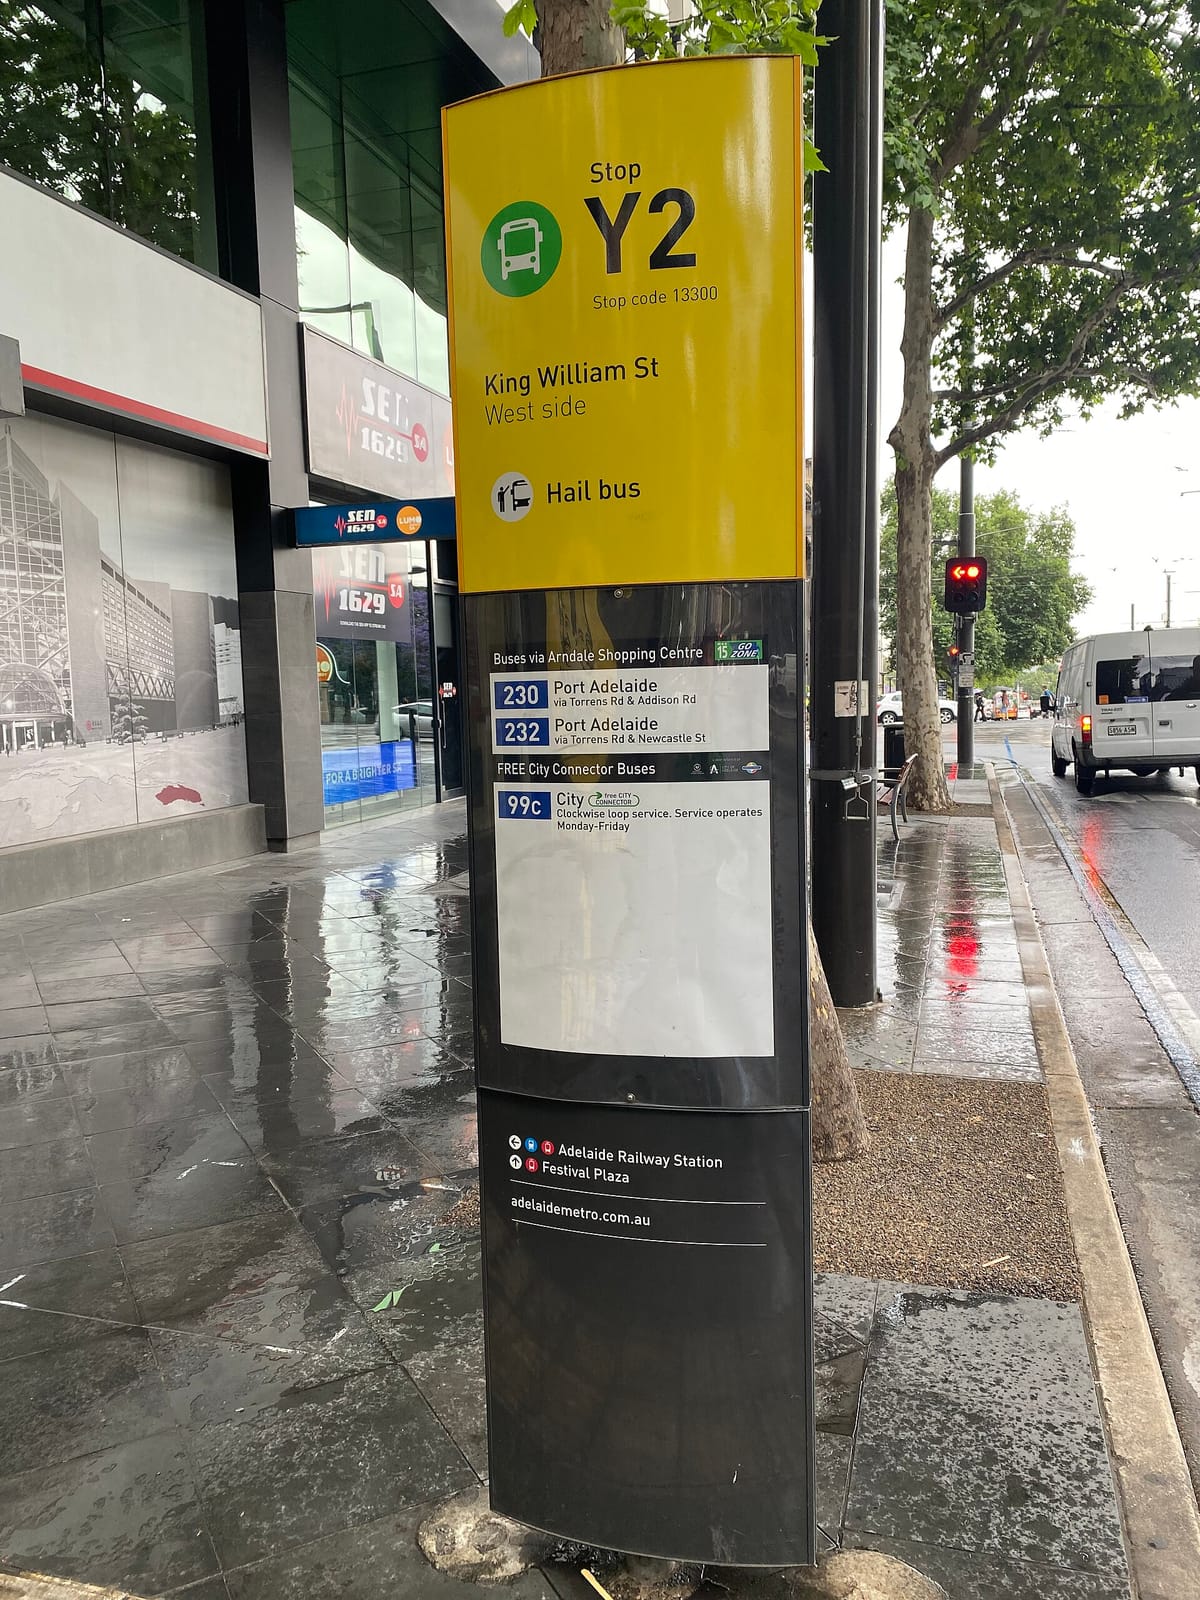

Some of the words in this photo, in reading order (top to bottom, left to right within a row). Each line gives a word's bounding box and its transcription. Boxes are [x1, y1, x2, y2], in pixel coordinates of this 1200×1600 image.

[590, 162, 642, 184] Stop
[583, 187, 697, 274] Y2
[592, 295, 626, 311] Stop
[631, 289, 667, 307] code
[673, 286, 719, 303] 13300
[485, 373, 531, 397] King
[537, 363, 626, 389] William
[634, 356, 659, 379] St
[484, 401, 534, 426] West
[542, 395, 587, 419] side
[547, 480, 591, 504] Hail
[599, 478, 641, 500] bus
[347, 509, 376, 522] SEN
[347, 523, 375, 533] 1629
[340, 547, 385, 583] SEN
[390, 583, 402, 599] SA
[339, 588, 386, 615] 1629
[493, 652, 526, 665] Buses
[529, 651, 545, 664] via
[548, 649, 595, 663] Arndale
[598, 647, 656, 664] Shopping
[660, 646, 703, 659] Centre
[717, 645, 728, 659] 15
[730, 650, 759, 658] ZONE
[738, 642, 752, 650] GO
[503, 685, 539, 705] 230
[554, 681, 585, 694] Port
[589, 678, 658, 693] Adelaide
[553, 698, 567, 707] via
[570, 697, 608, 707] Torrens
[610, 696, 624, 705] Rd
[627, 696, 635, 706] &
[637, 695, 679, 705] Addison
[682, 694, 696, 704] Rd
[504, 722, 540, 742] 232
[555, 719, 586, 732] Port
[590, 717, 658, 731] Adelaide
[554, 736, 568, 744] via
[570, 735, 609, 744] Torrens
[611, 734, 625, 744] Rd
[627, 734, 635, 744] &
[638, 733, 692, 744] Newcastle
[695, 733, 706, 743] St
[325, 771, 344, 784] FOR
[352, 763, 391, 781] BRIGHTER
[497, 762, 526, 775] FREE
[528, 762, 550, 777] City
[552, 762, 613, 775] Connector
[617, 762, 656, 775] Buses
[508, 795, 541, 815] 99c
[556, 792, 584, 808] City
[556, 808, 605, 818] Clockwise
[608, 808, 630, 820] loop
[632, 808, 672, 819] service.
[674, 808, 713, 818] Service
[716, 807, 763, 821] operates
[557, 821, 630, 832] Monday-Friday
[558, 1143, 614, 1162] Adelaide
[618, 1150, 670, 1169] Railway
[674, 1154, 723, 1169] Station
[542, 1160, 590, 1180] Festival
[594, 1168, 630, 1184] Plaza
[511, 1196, 651, 1227] adelaidemetro.com.au
